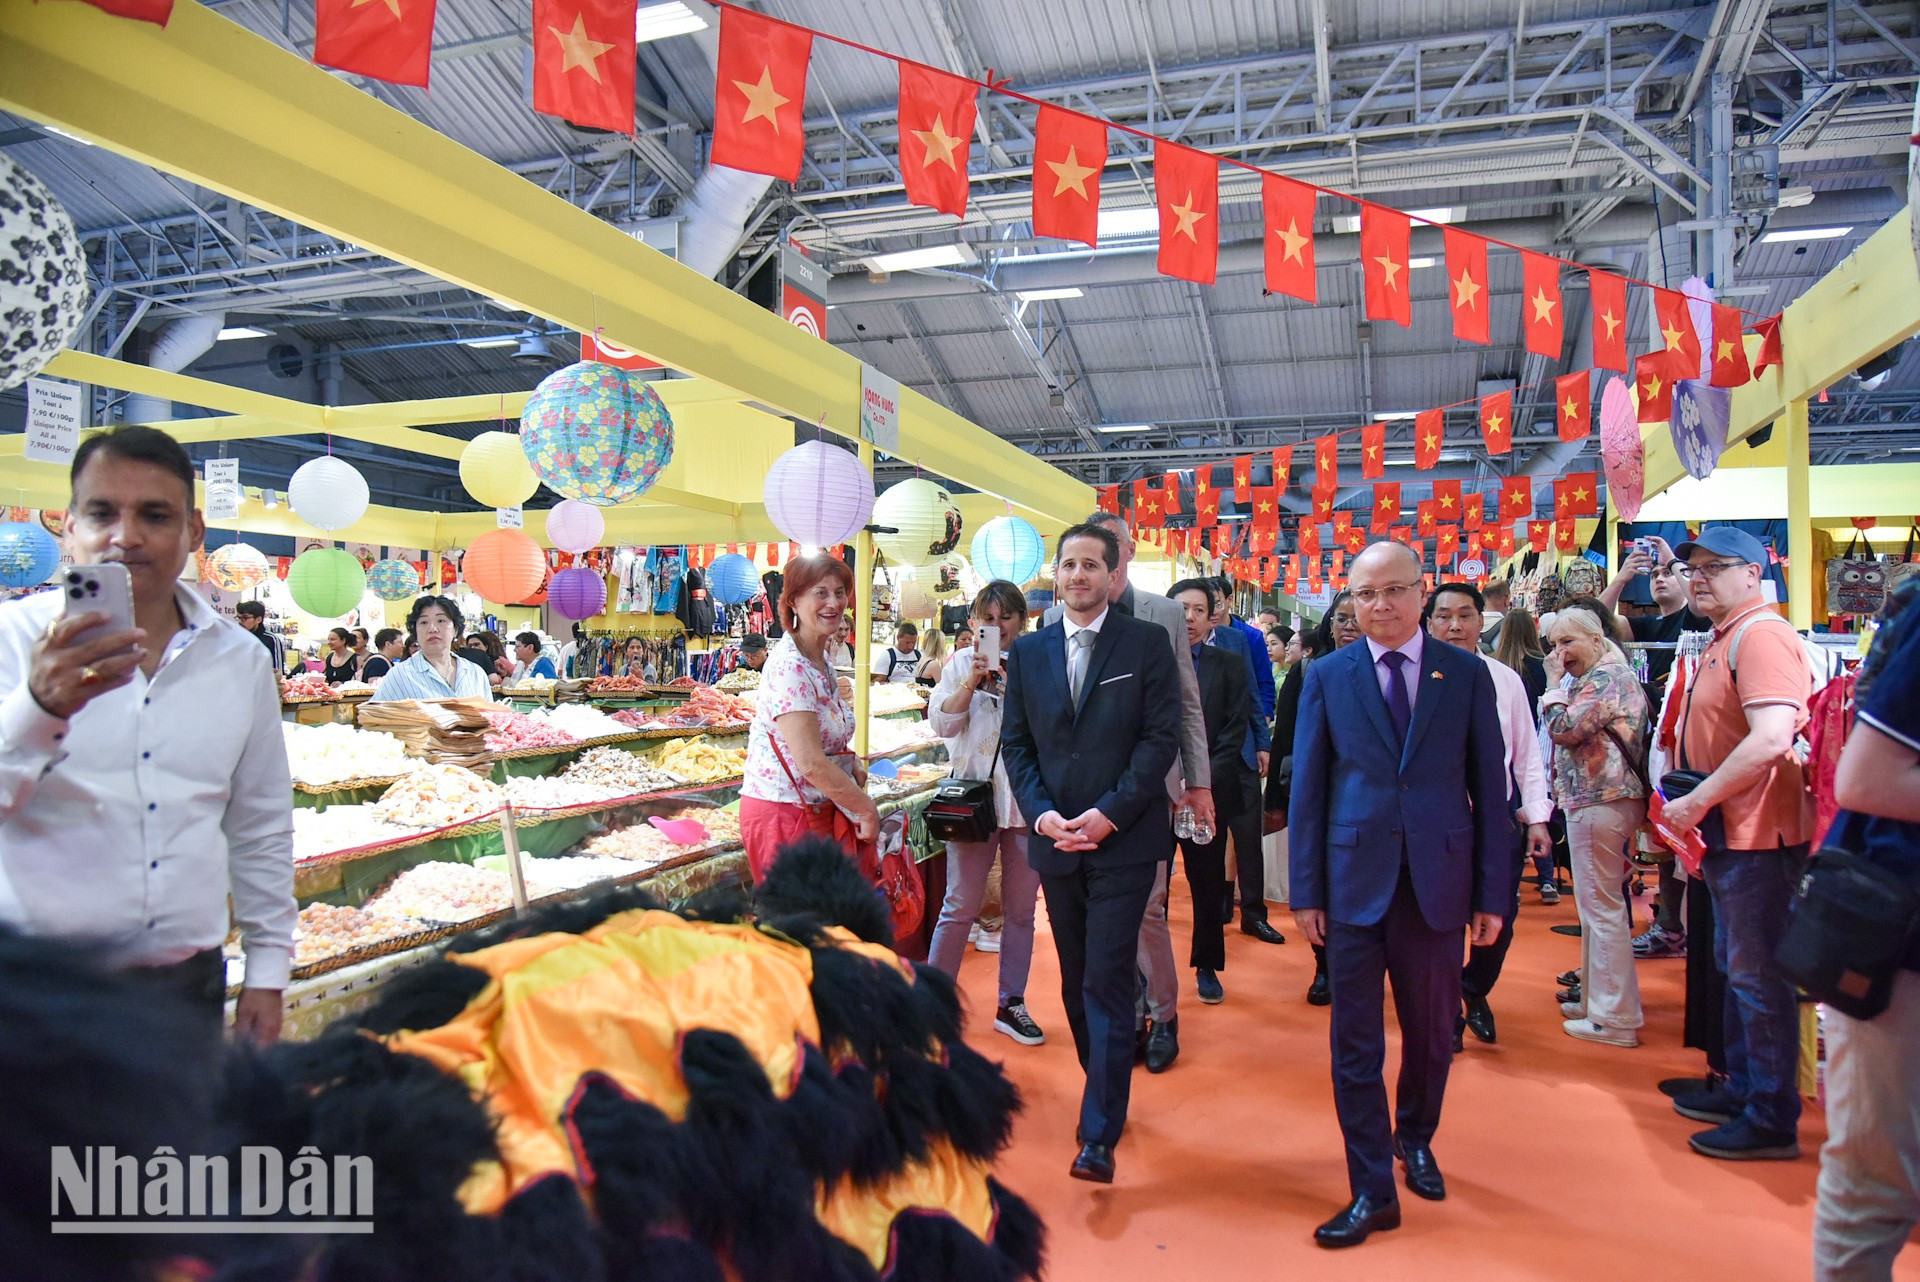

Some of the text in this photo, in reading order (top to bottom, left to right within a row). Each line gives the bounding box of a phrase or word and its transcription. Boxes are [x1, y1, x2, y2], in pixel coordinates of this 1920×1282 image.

[625, 230, 644, 242] 10
[800, 264, 813, 281] 2210
[35, 388, 73, 402] Prix Unique
[43, 399, 57, 408] Tout
[32, 408, 75, 423] 7,90 €/100gr
[34, 420, 72, 433] Unique Price
[40, 431, 50, 439] All
[30, 440, 72, 454] 7,90€/100gr
[225, 606, 235, 614] tea
